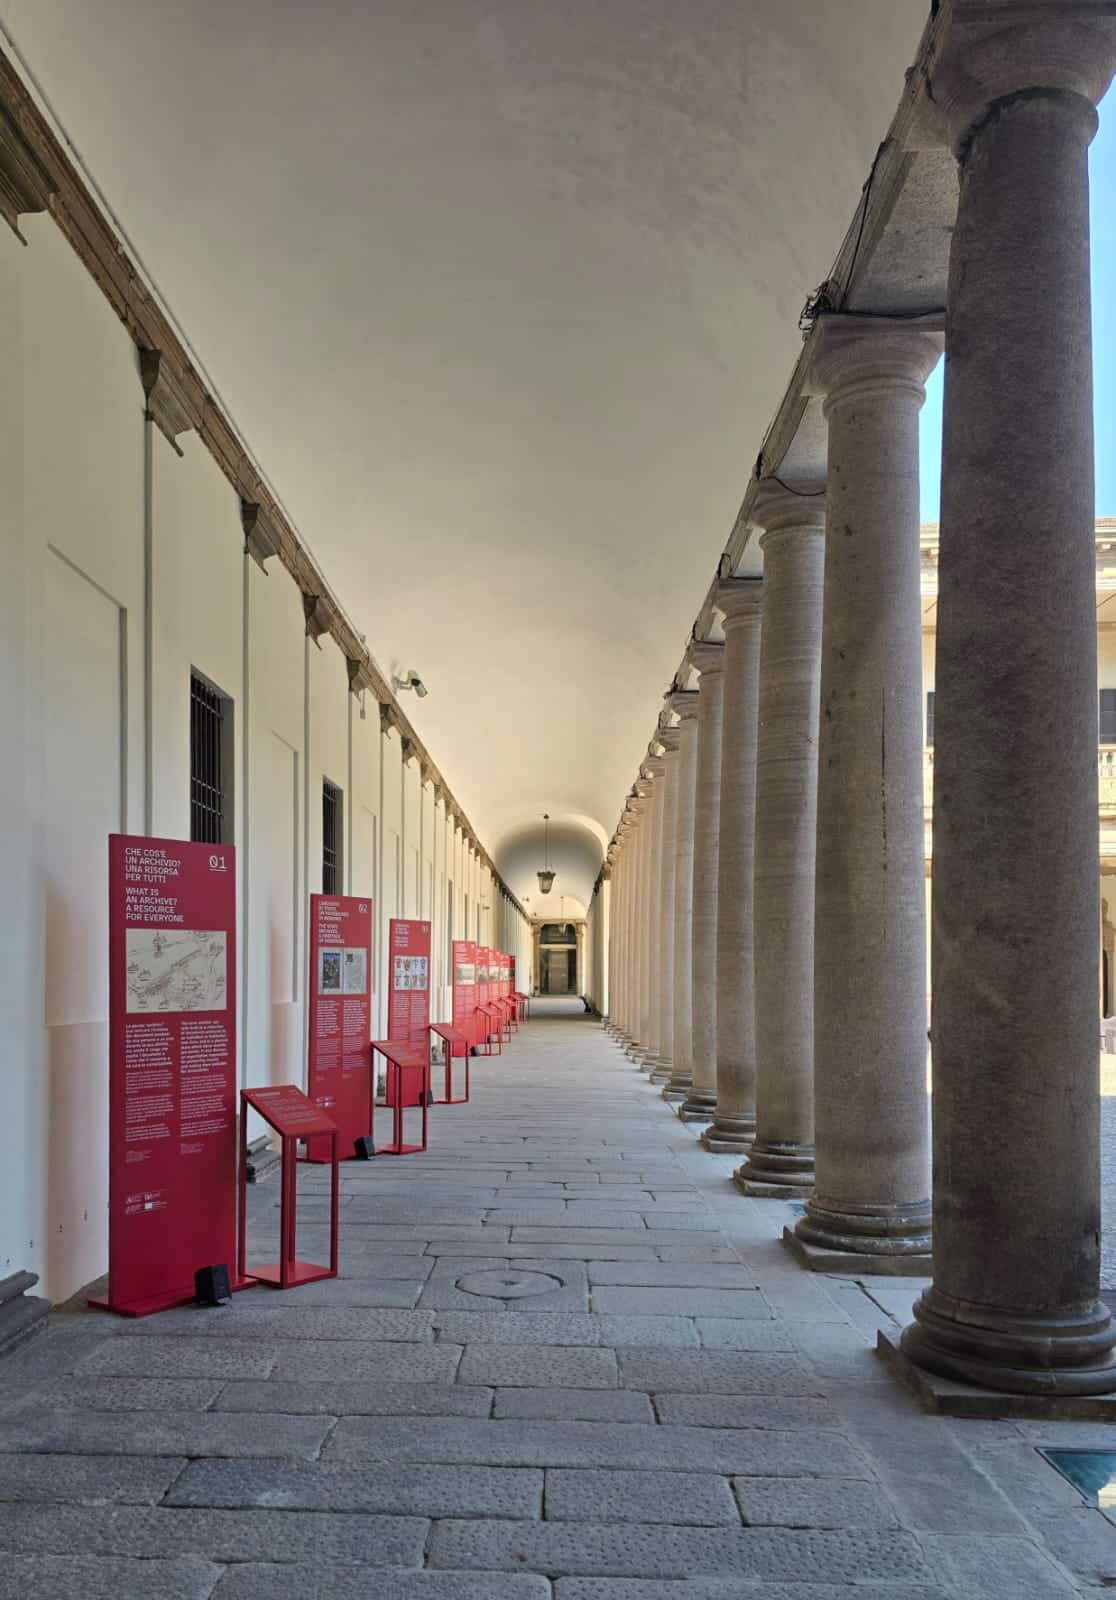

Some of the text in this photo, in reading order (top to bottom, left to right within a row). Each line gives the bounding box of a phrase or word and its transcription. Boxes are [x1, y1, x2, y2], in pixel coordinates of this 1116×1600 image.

[125, 848, 142, 856] CHE
[125, 856, 181, 868] UN ARCHIVIO?
[209, 855, 228, 868] 01
[125, 864, 178, 875] UNA RISORSA
[125, 873, 166, 884] PER TUTTI
[125, 887, 159, 896] WHAT IS
[126, 896, 177, 906] AN ARCHIVE?
[133, 904, 176, 914] RESOURCE
[126, 912, 184, 922] FOR EVERYONE
